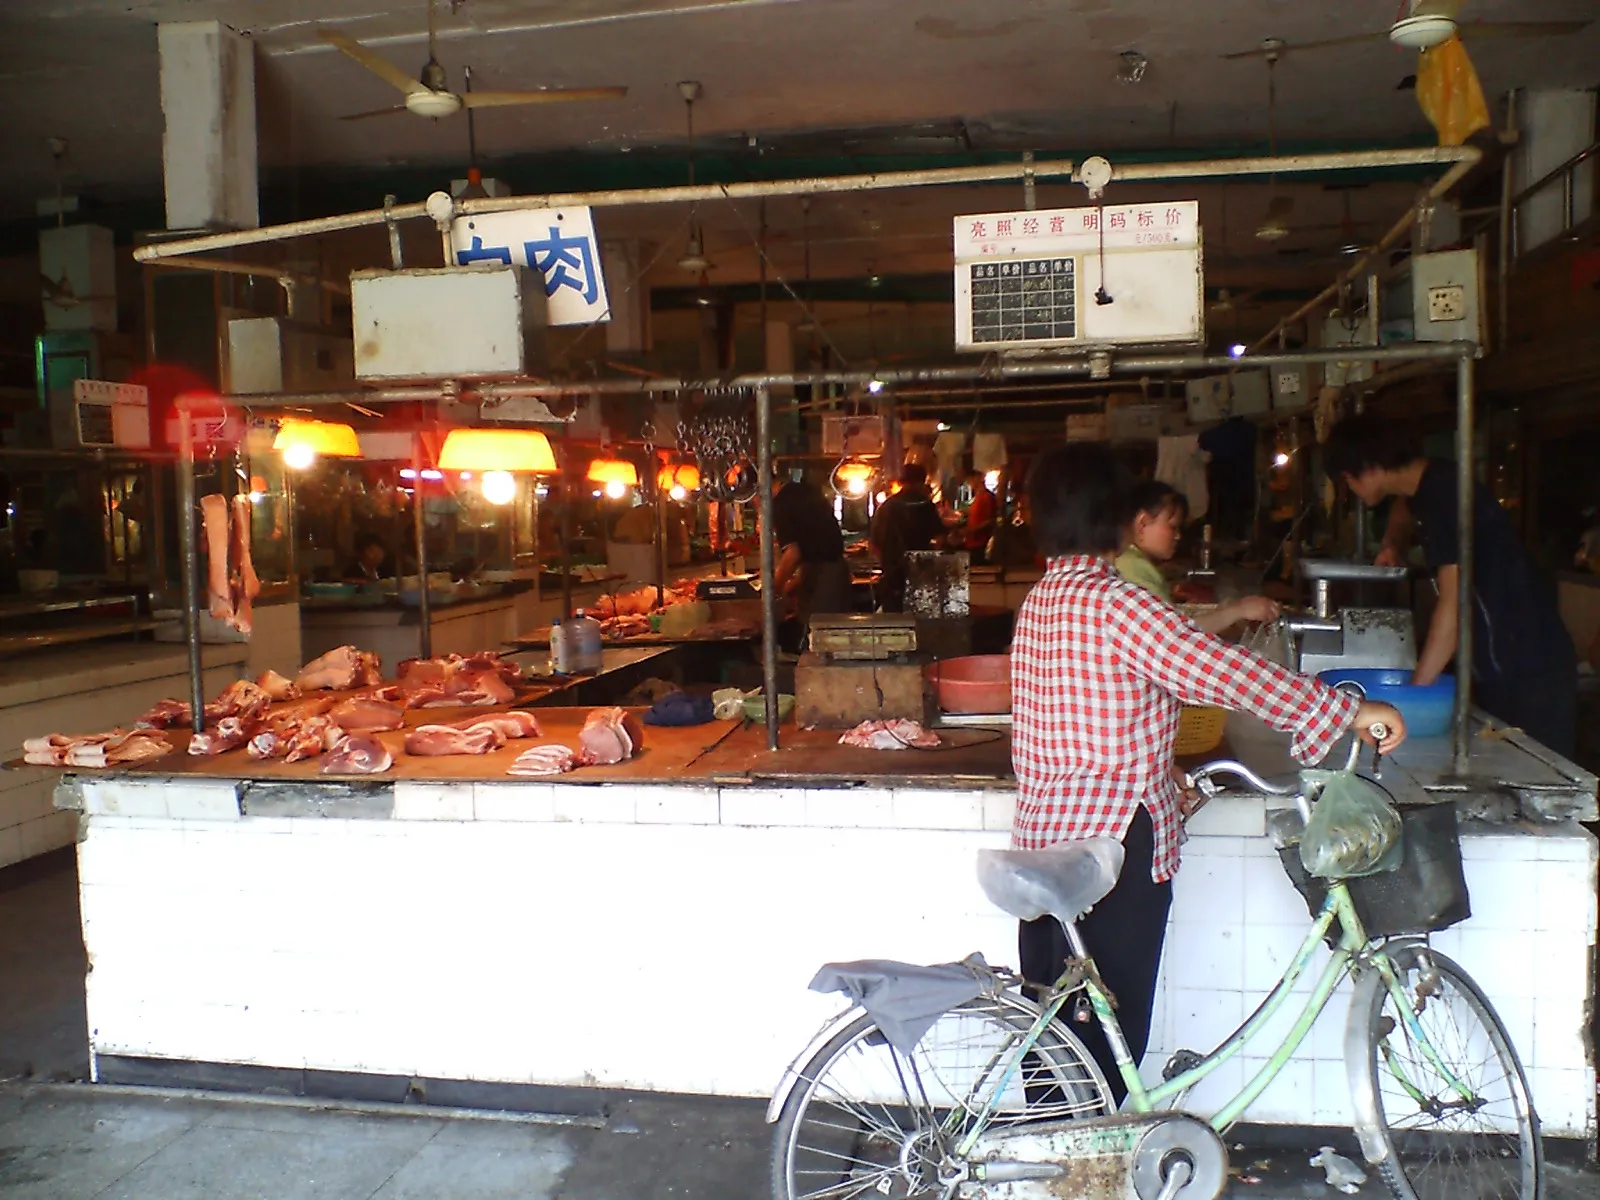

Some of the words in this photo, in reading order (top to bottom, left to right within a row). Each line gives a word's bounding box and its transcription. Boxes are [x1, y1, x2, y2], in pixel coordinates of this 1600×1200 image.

[970, 216, 1065, 237] 亮照经营
[1082, 208, 1182, 230] 明码标价
